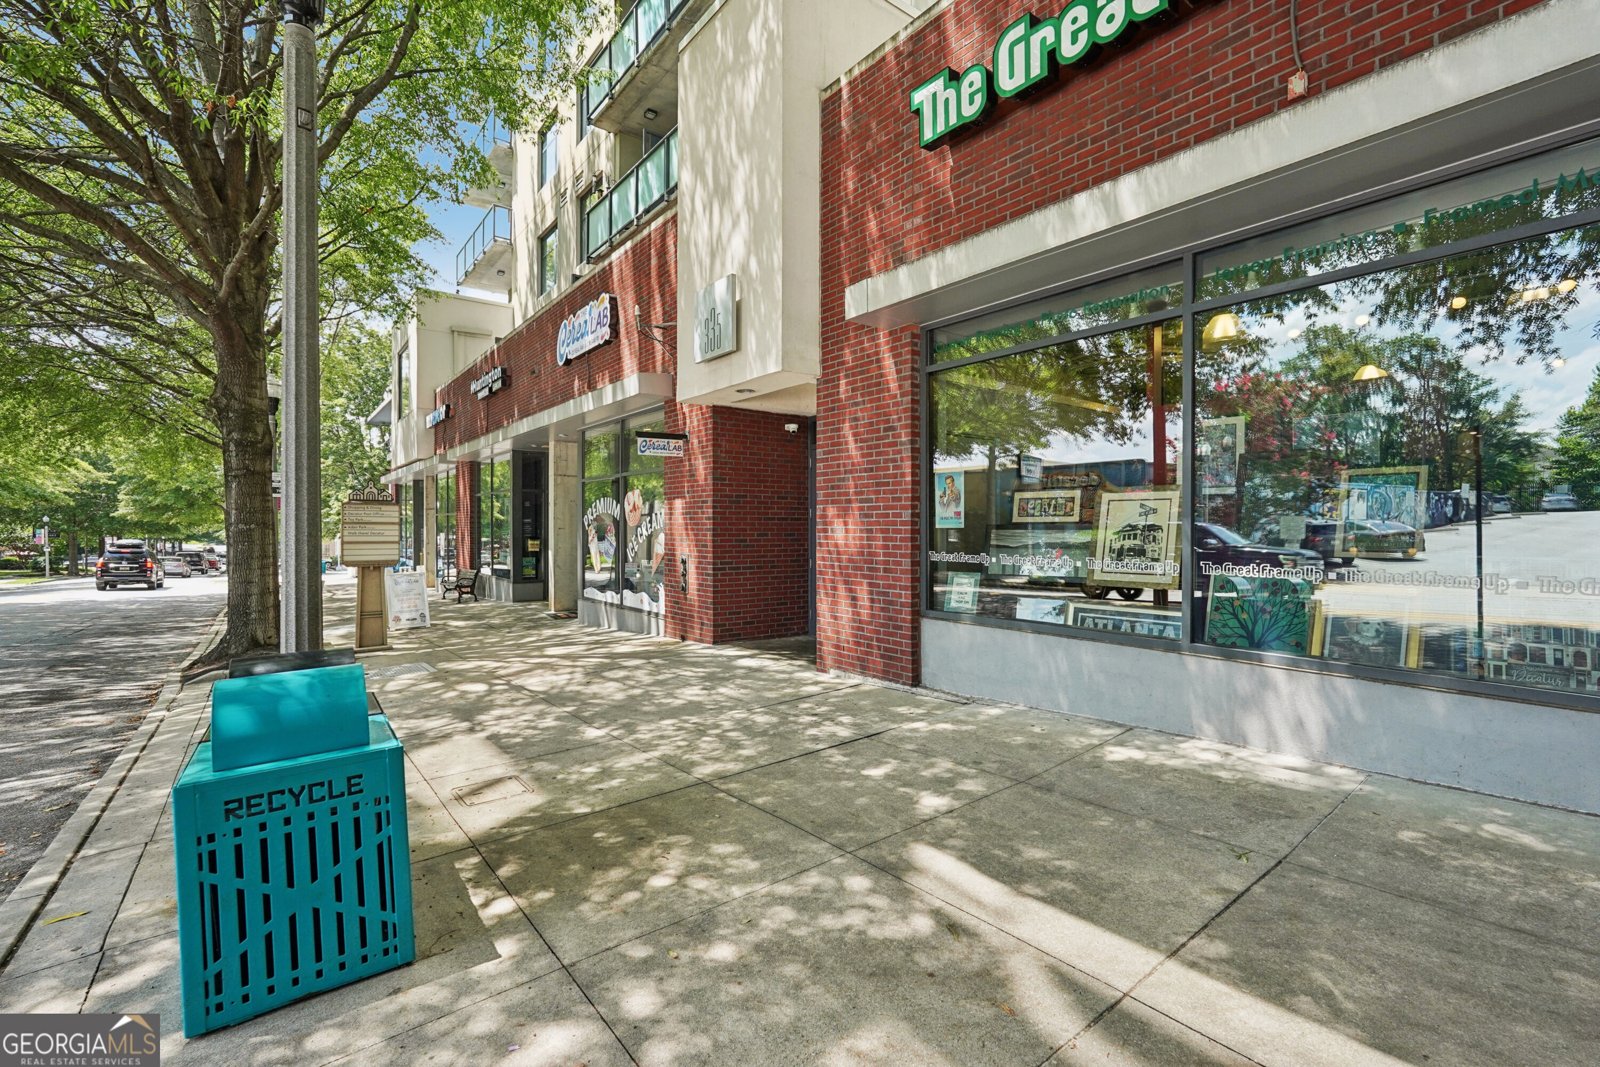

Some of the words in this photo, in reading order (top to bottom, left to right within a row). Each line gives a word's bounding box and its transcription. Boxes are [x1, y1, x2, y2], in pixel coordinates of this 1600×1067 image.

[911, 67, 987, 148] The
[1424, 178, 1539, 229] Framed
[1282, 230, 1377, 262] Framing
[667, 444, 683, 452] LAB
[584, 497, 620, 530] PREMIUM
[627, 535, 639, 562] ICE
[929, 551, 940, 561] The
[940, 552, 959, 562] Great
[959, 552, 980, 563] Frame
[980, 553, 990, 566] Up
[1000, 554, 1013, 565] The
[1014, 555, 1035, 567] Great
[1035, 555, 1061, 568] Frame
[1062, 555, 1074, 568] Up
[1086, 557, 1102, 569] The
[1103, 558, 1130, 571] Great
[1130, 559, 1164, 574] Frame
[1165, 560, 1180, 576] Up
[1200, 561, 1221, 575] The
[1222, 562, 1259, 577] Great
[1260, 564, 1303, 580] Frame
[1303, 566, 1323, 584] Up
[1343, 567, 1372, 583] The
[1373, 569, 1422, 586] Great
[1423, 570, 1480, 590] Frame
[1484, 573, 1510, 595] Up
[1535, 575, 1576, 595] The
[224, 773, 364, 822] RECYCLE
